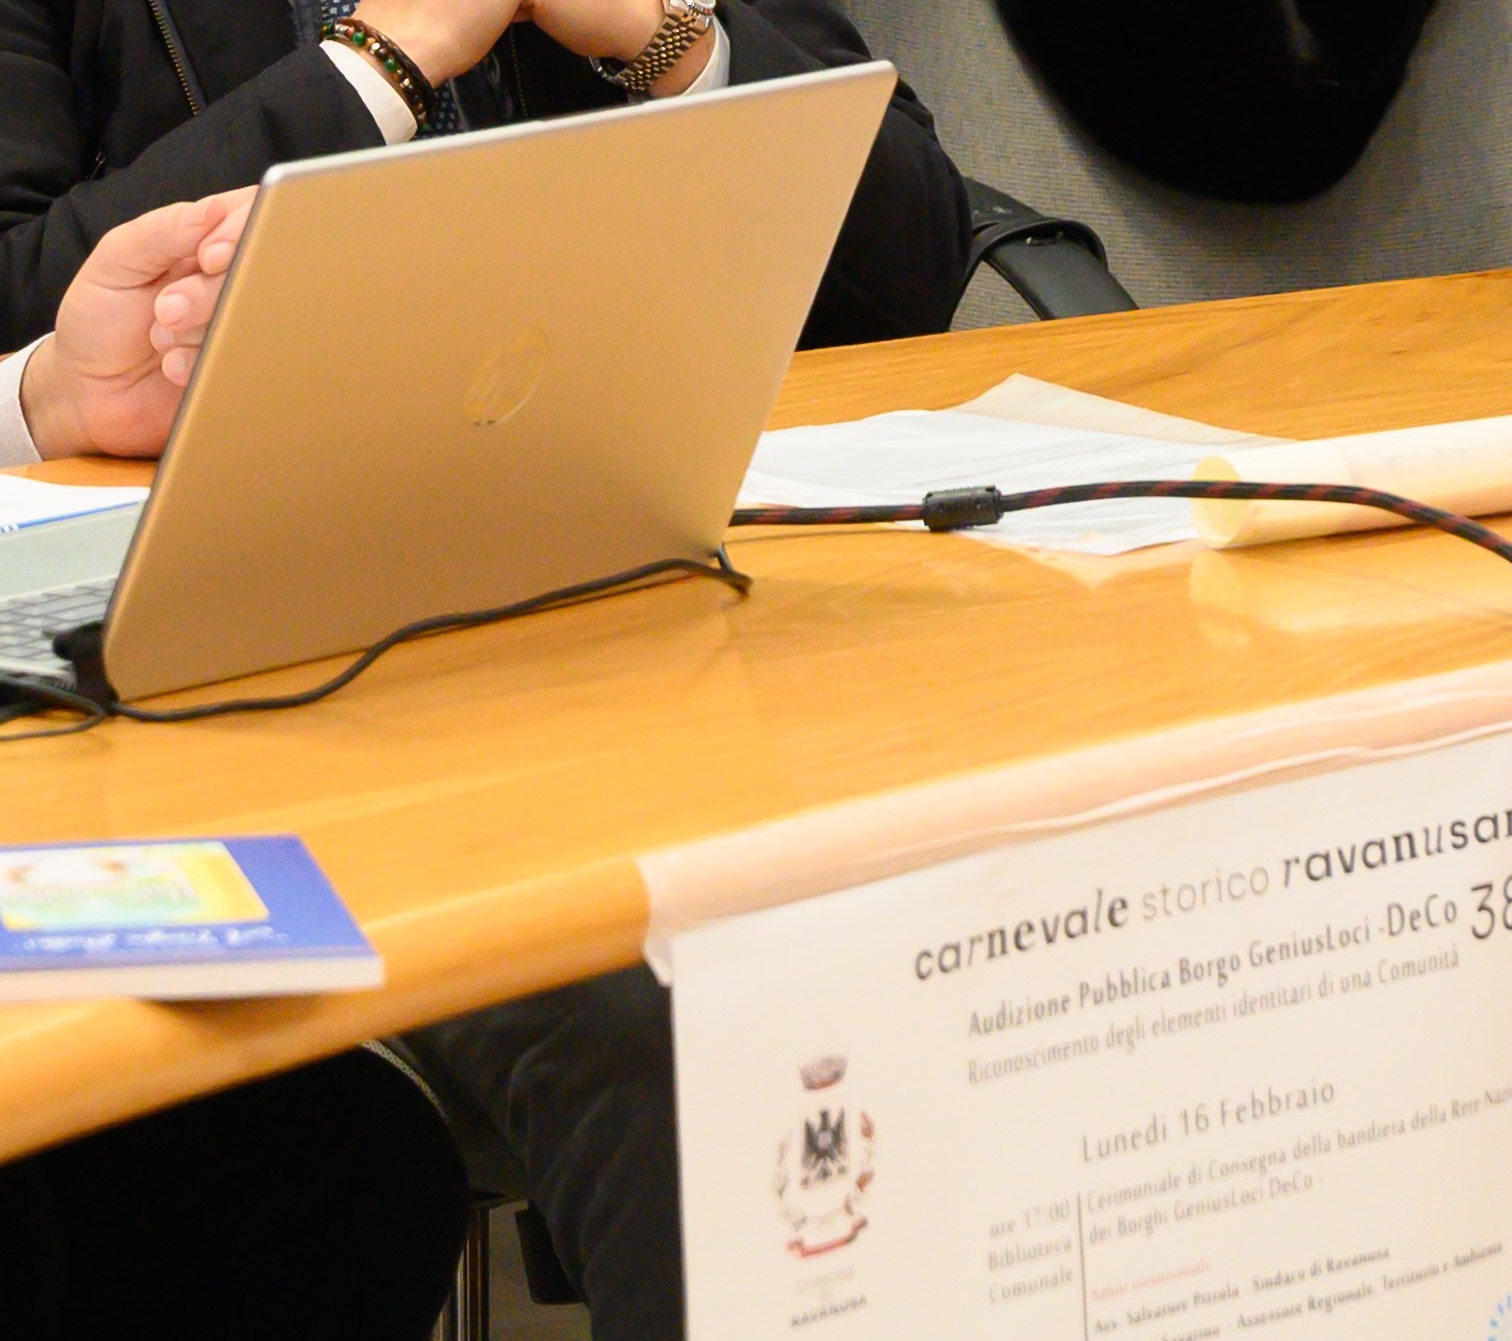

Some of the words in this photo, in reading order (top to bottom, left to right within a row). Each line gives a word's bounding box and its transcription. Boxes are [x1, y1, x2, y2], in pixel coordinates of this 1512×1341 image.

[914, 886, 1130, 982] carnevale
[1142, 865, 1270, 922] storico
[968, 992, 1071, 1040] Audizione
[1078, 967, 1172, 1010] Pubblica
[1178, 951, 1241, 988] Borgo
[1248, 915, 1371, 969] GeniusLoci
[968, 1032, 1100, 1086] Riconoscimento
[1105, 1016, 1146, 1054] degli
[1151, 1003, 1228, 1039] elementi
[1233, 976, 1312, 1018] identitari
[1318, 970, 1335, 997] di
[1340, 971, 1372, 994] una
[1378, 943, 1459, 985] Comunità
[1088, 1169, 1181, 1212] Cerimoniale
[1187, 1163, 1202, 1186] di
[1208, 1148, 1287, 1181] Consegna
[1292, 1132, 1332, 1161] della
[1337, 1119, 1406, 1149] bandiera
[1411, 1104, 1447, 1132] della
[1178, 1102, 1210, 1135] 16
[1219, 1077, 1335, 1128] Febbraio
[988, 1237, 1072, 1271] Biblioteca
[989, 1264, 1073, 1304] Comunale
